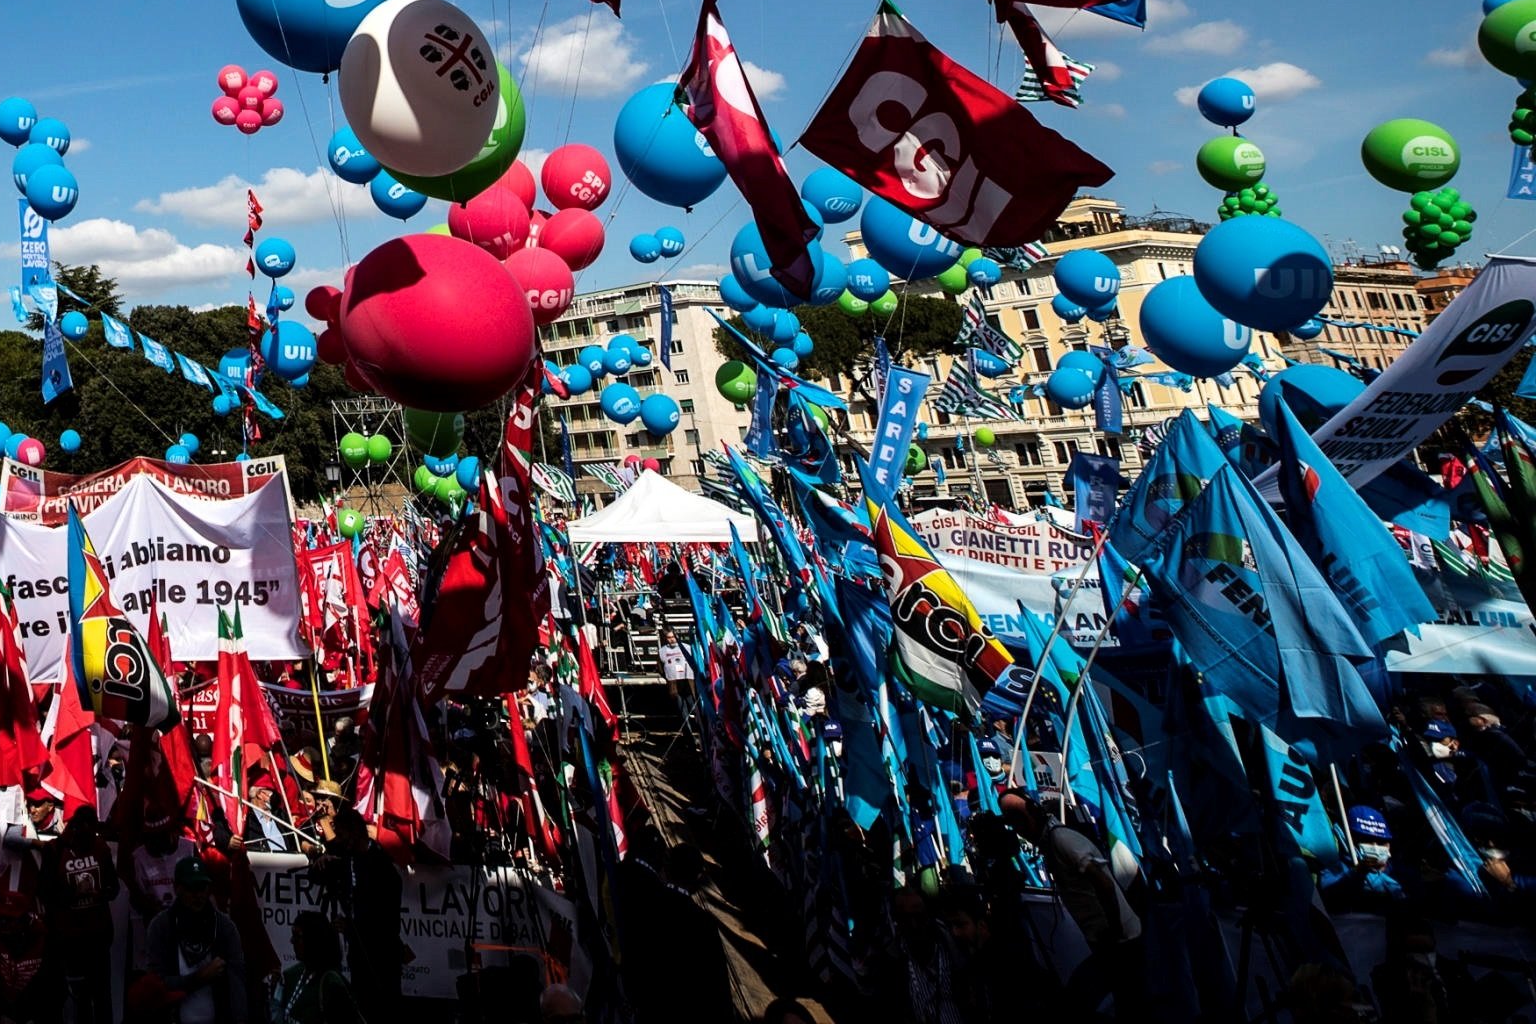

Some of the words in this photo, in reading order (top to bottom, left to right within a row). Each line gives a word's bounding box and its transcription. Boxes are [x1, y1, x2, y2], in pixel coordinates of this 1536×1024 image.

[849, 70, 1014, 247] CGIL
[1412, 146, 1449, 157] CISL
[22, 241, 47, 254] ZERO
[1467, 322, 1518, 344] CISL
[283, 344, 314, 361] UIL
[9, 464, 41, 483] CGIL
[247, 463, 279, 476] CGIL
[165, 474, 230, 495] LAVORO
[932, 515, 959, 530] CISL
[1007, 524, 1040, 537] CGIL
[951, 530, 1037, 559] GIANETTI
[1048, 542, 1096, 563] RUO
[968, 552, 1028, 570] DIRITTI
[1034, 558, 1045, 570] E
[65, 856, 98, 871] CGIL
[400, 916, 486, 941] VINCIALE
